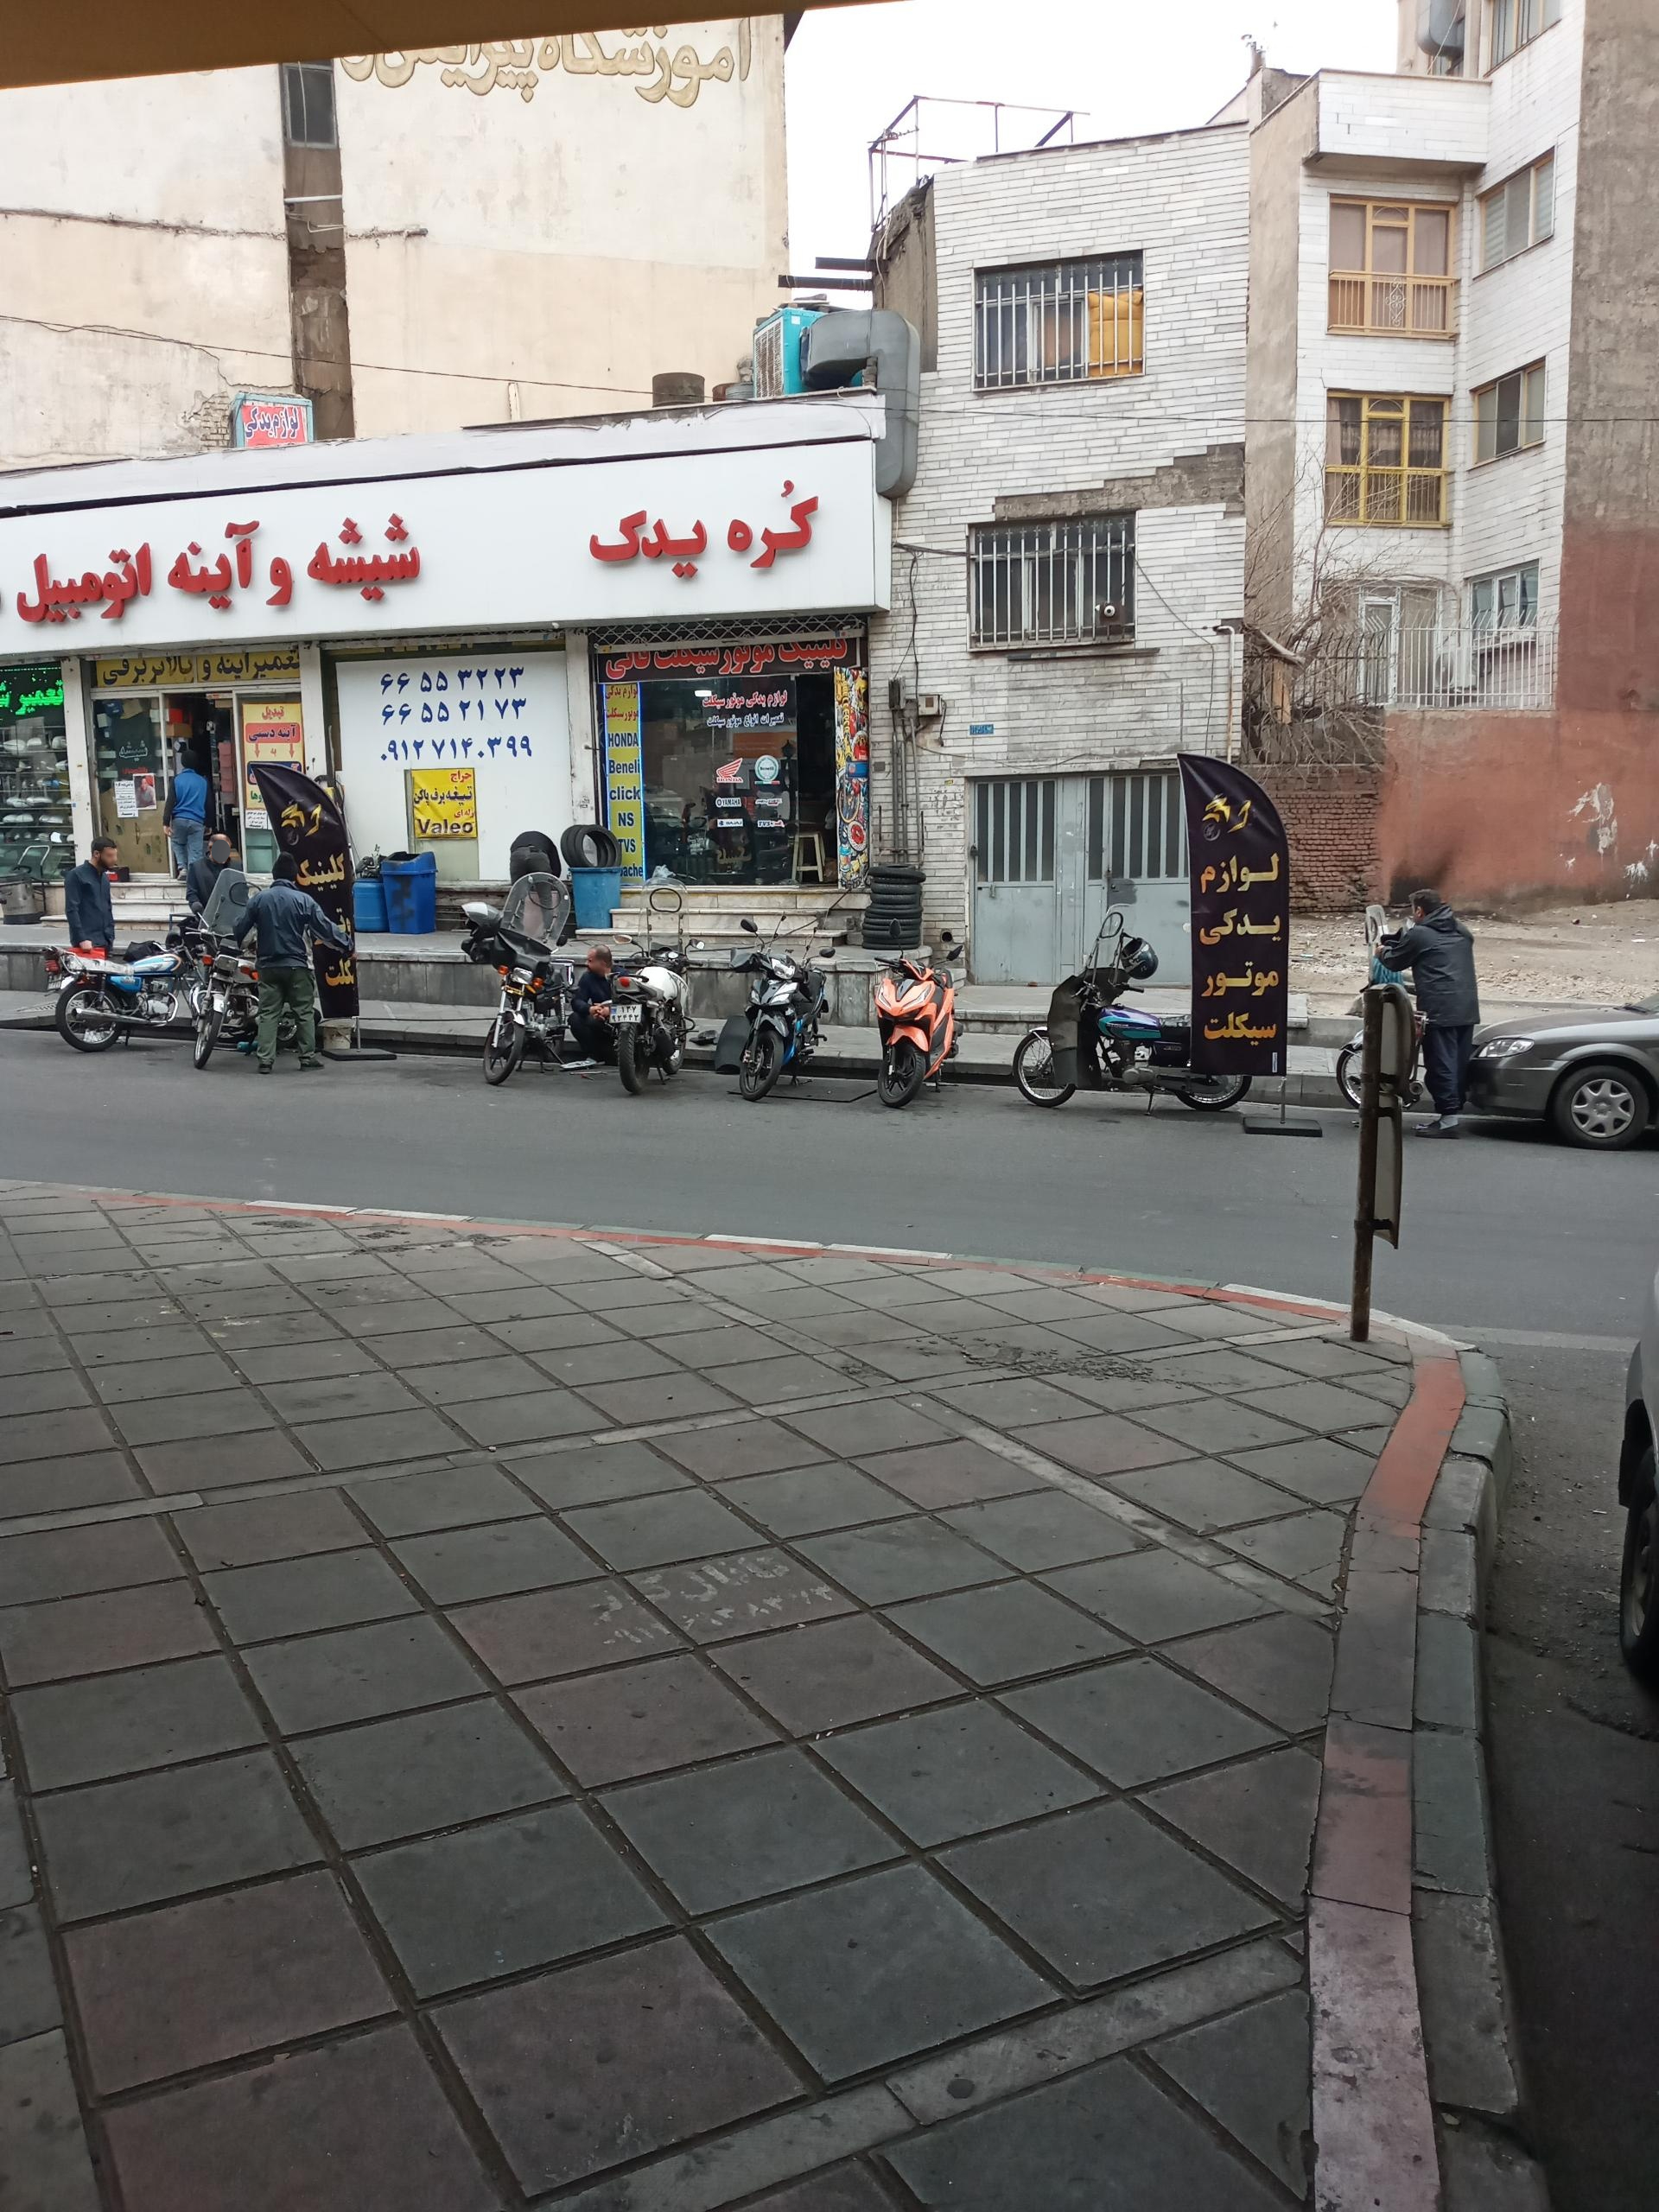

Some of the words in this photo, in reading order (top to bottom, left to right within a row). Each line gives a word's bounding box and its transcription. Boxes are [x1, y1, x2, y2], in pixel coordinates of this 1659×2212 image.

[245, 406, 273, 439] یدکی
[271, 406, 300, 439] لوازم
[307, 513, 421, 602] شیشه
[589, 510, 708, 578] یدک
[168, 520, 260, 609] آینه
[266, 556, 293, 606] و
[16, 542, 152, 623] اتومبیل
[767, 690, 788, 708] لوازم
[608, 732, 639, 747] HONDA
[450, 770, 472, 783] حراج
[609, 785, 641, 800] click
[430, 787, 445, 804] برف
[446, 785, 473, 806] تیغه
[416, 818, 474, 834] Valeo
[618, 812, 634, 827] NS
[620, 863, 643, 877] ache
[1200, 853, 1280, 893] لوازم
[1199, 908, 1281, 945] یدکی
[1201, 961, 1280, 997] موتور
[1204, 1012, 1277, 1046] سیکلت
